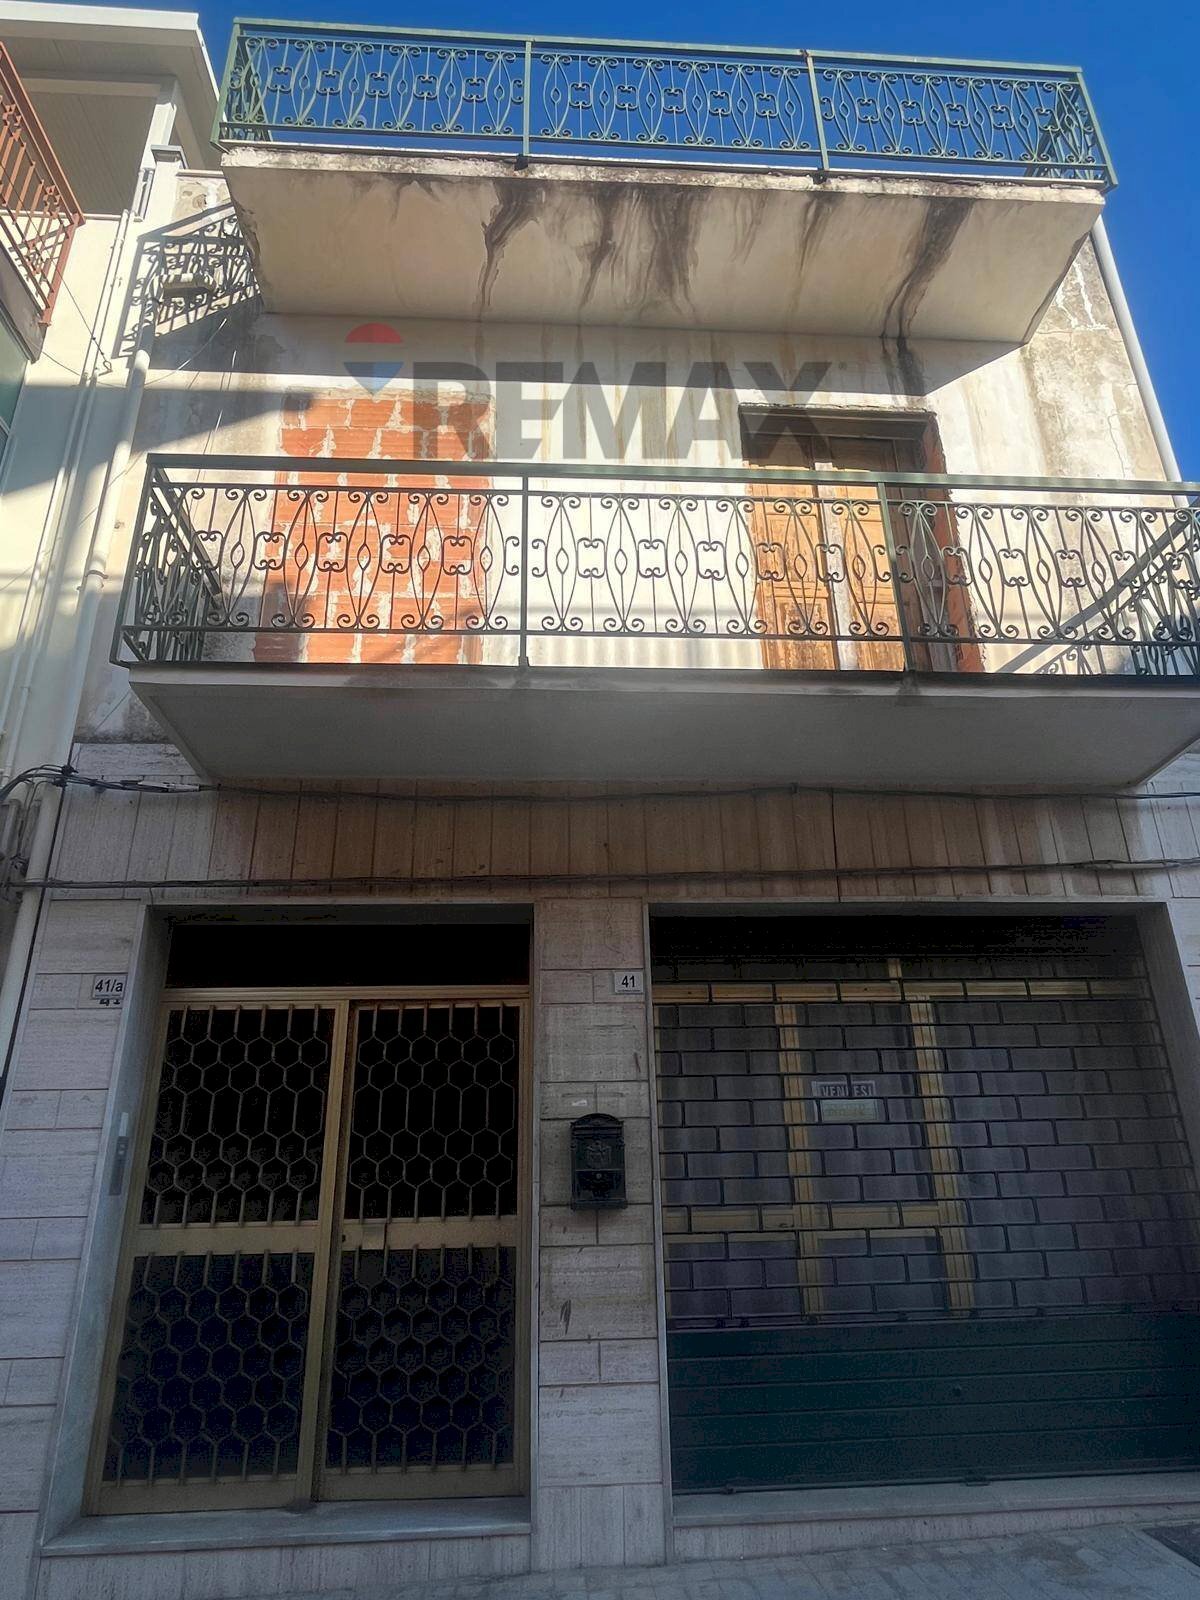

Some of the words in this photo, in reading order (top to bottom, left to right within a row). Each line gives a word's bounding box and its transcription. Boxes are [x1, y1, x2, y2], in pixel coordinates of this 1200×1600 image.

[95, 979, 123, 992] 41/a
[621, 975, 635, 988] 41
[821, 1085, 873, 1097] VENESI
